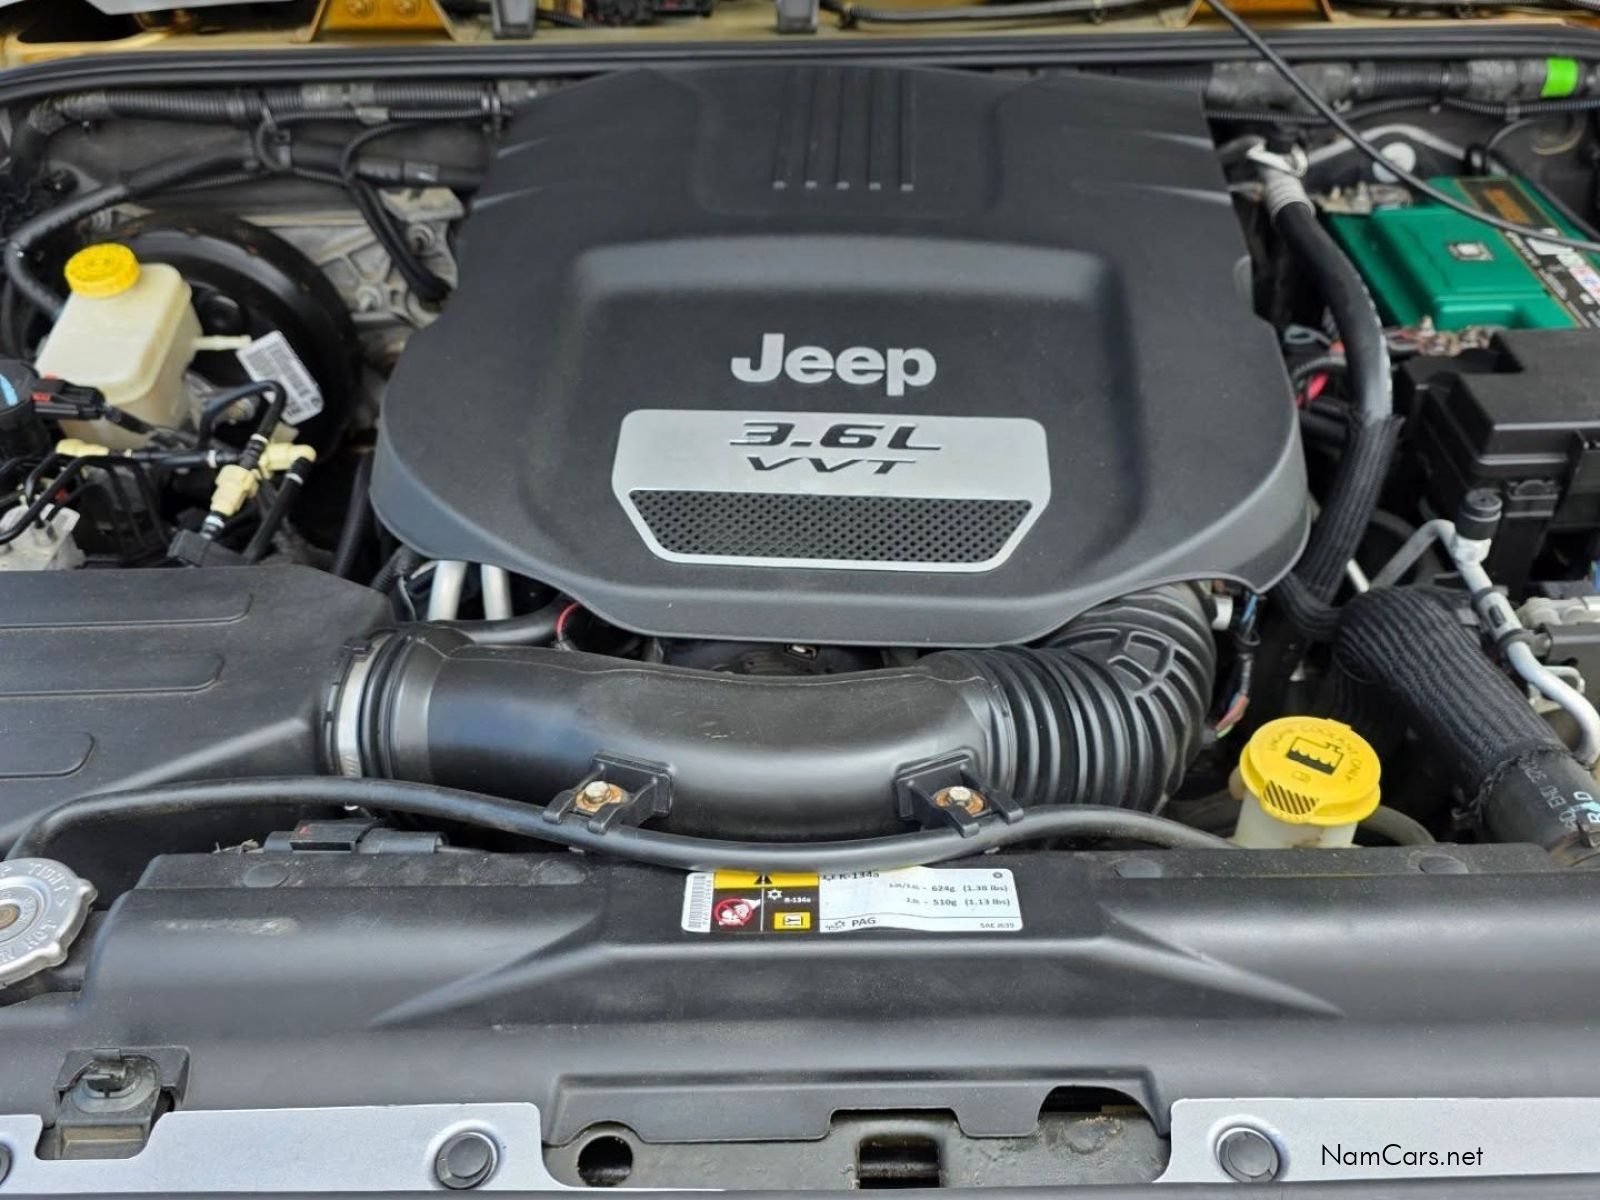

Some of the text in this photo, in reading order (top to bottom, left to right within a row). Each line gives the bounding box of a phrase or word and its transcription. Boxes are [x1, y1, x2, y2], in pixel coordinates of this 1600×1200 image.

[731, 333, 936, 396] Jeep
[730, 421, 942, 451] 3.6L
[747, 456, 917, 475] VVT
[931, 885, 956, 893] 624g
[990, 884, 1008, 893] lbs)
[933, 898, 957, 907] 510g
[992, 898, 1010, 907] lbs)
[851, 917, 877, 928] PAG
